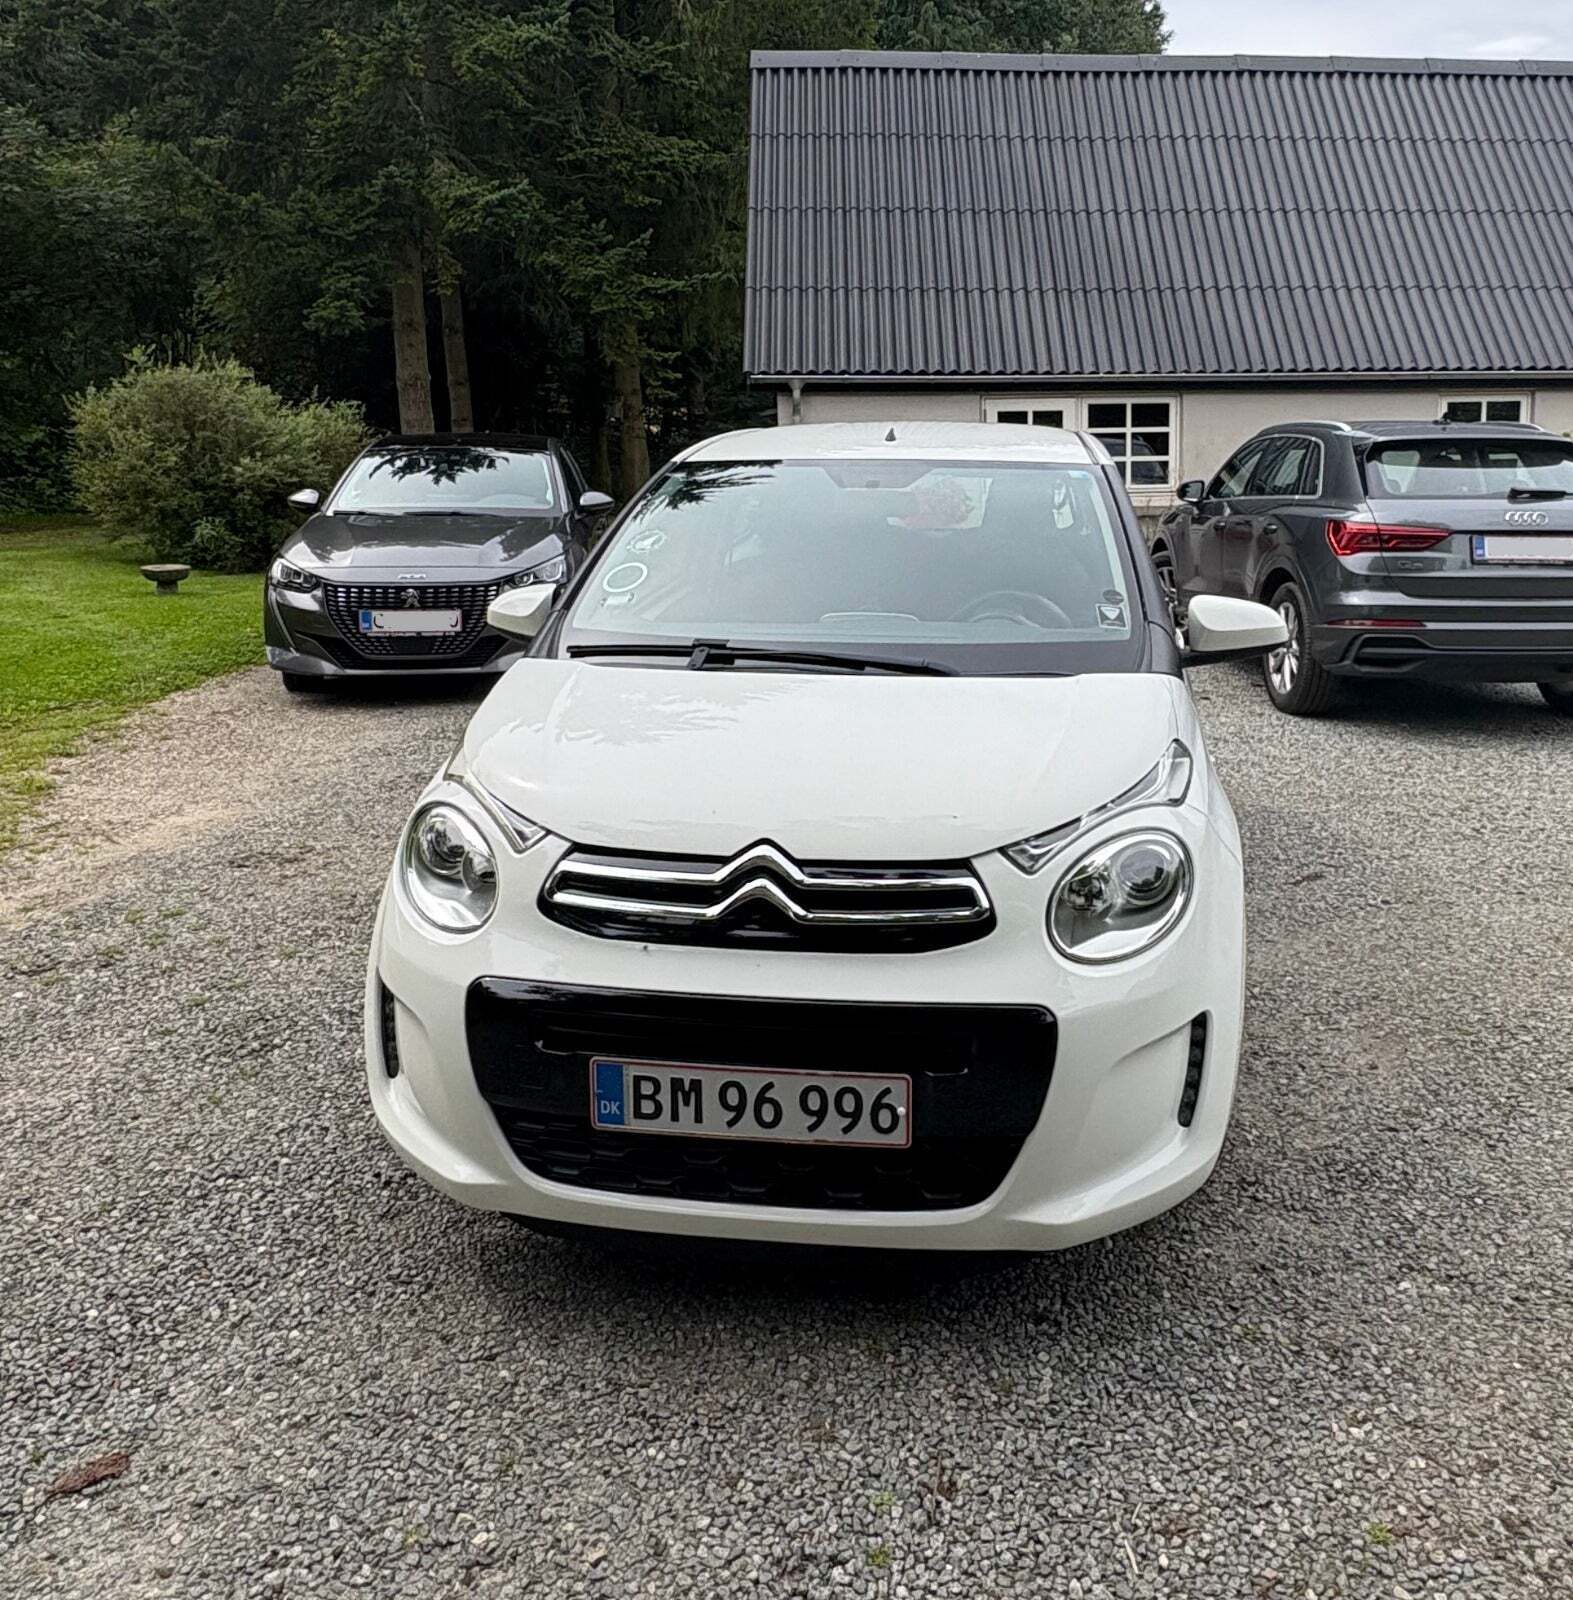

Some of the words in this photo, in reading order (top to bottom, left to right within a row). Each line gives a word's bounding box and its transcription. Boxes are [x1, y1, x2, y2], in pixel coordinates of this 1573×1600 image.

[601, 1101, 621, 1115] DK
[633, 1075, 703, 1124] BM
[719, 1080, 783, 1130] 96
[799, 1085, 900, 1135] 996
